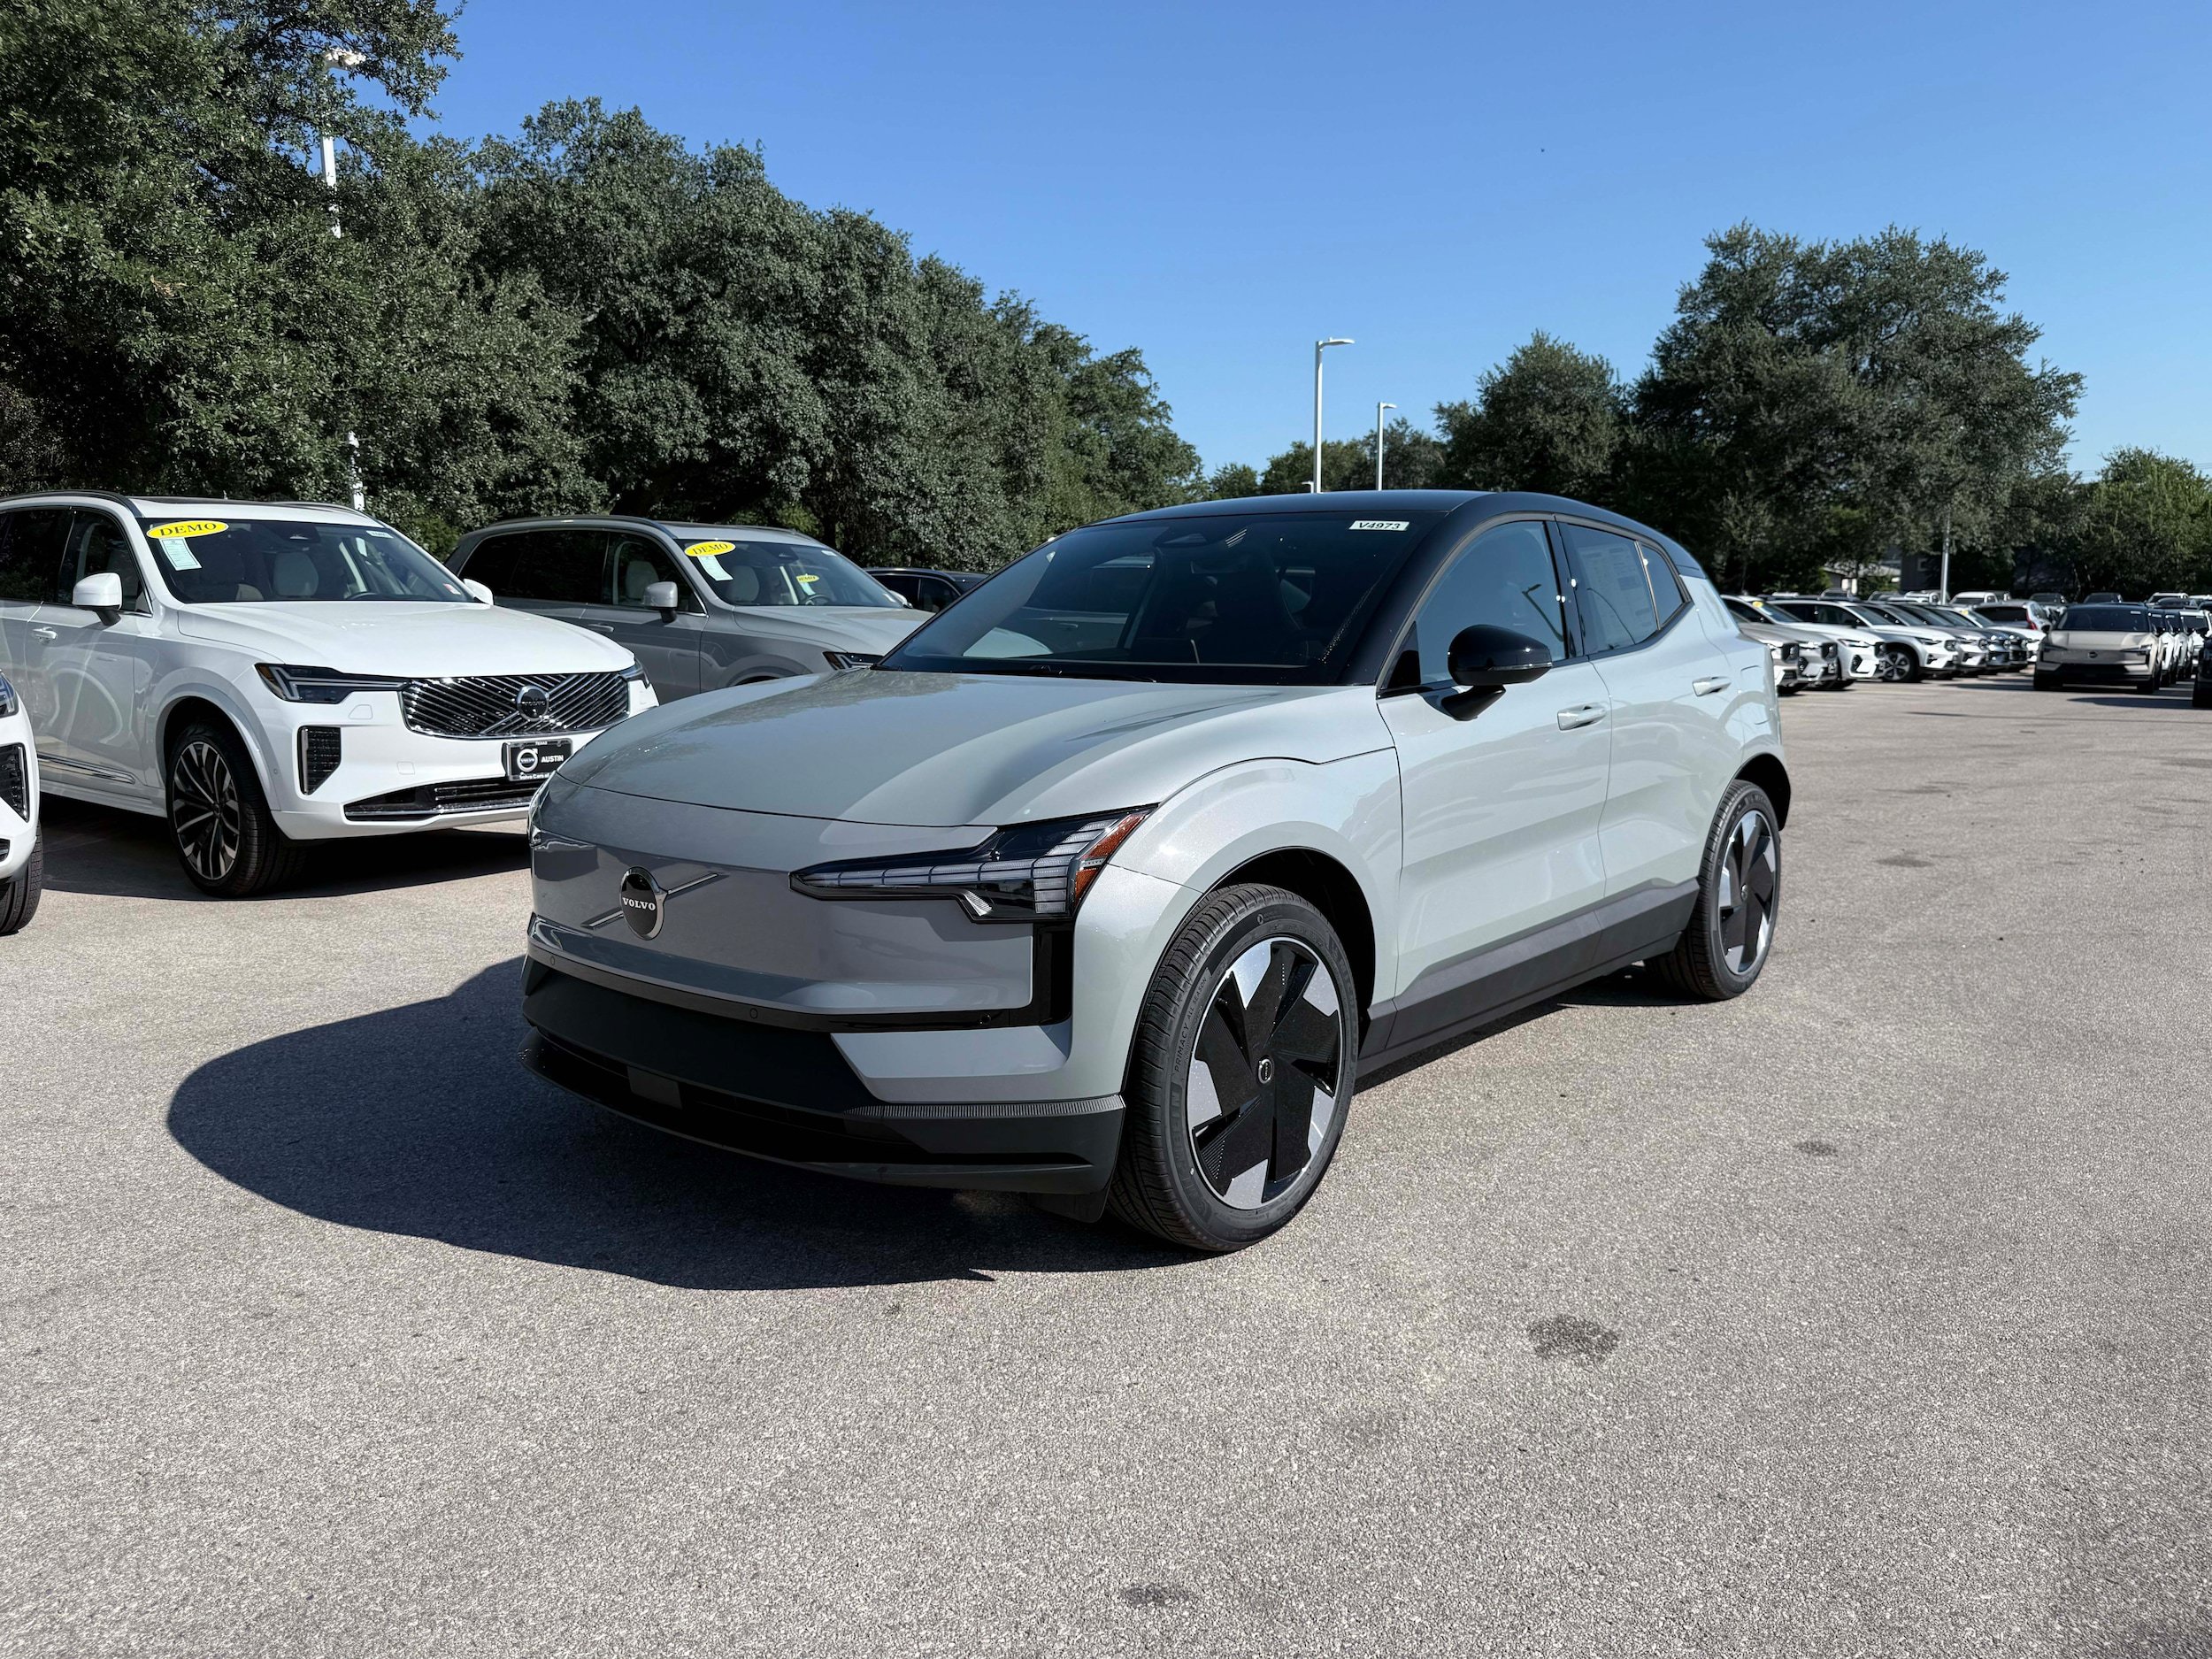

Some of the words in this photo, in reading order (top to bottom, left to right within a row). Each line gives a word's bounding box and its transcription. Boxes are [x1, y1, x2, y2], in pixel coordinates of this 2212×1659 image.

[160, 523, 216, 535] DEMO
[693, 543, 728, 554] DEMO
[622, 897, 656, 910] VOLVO
[1175, 1022, 1189, 1072] PRIMACY
[1192, 978, 1207, 1005] SEASON
